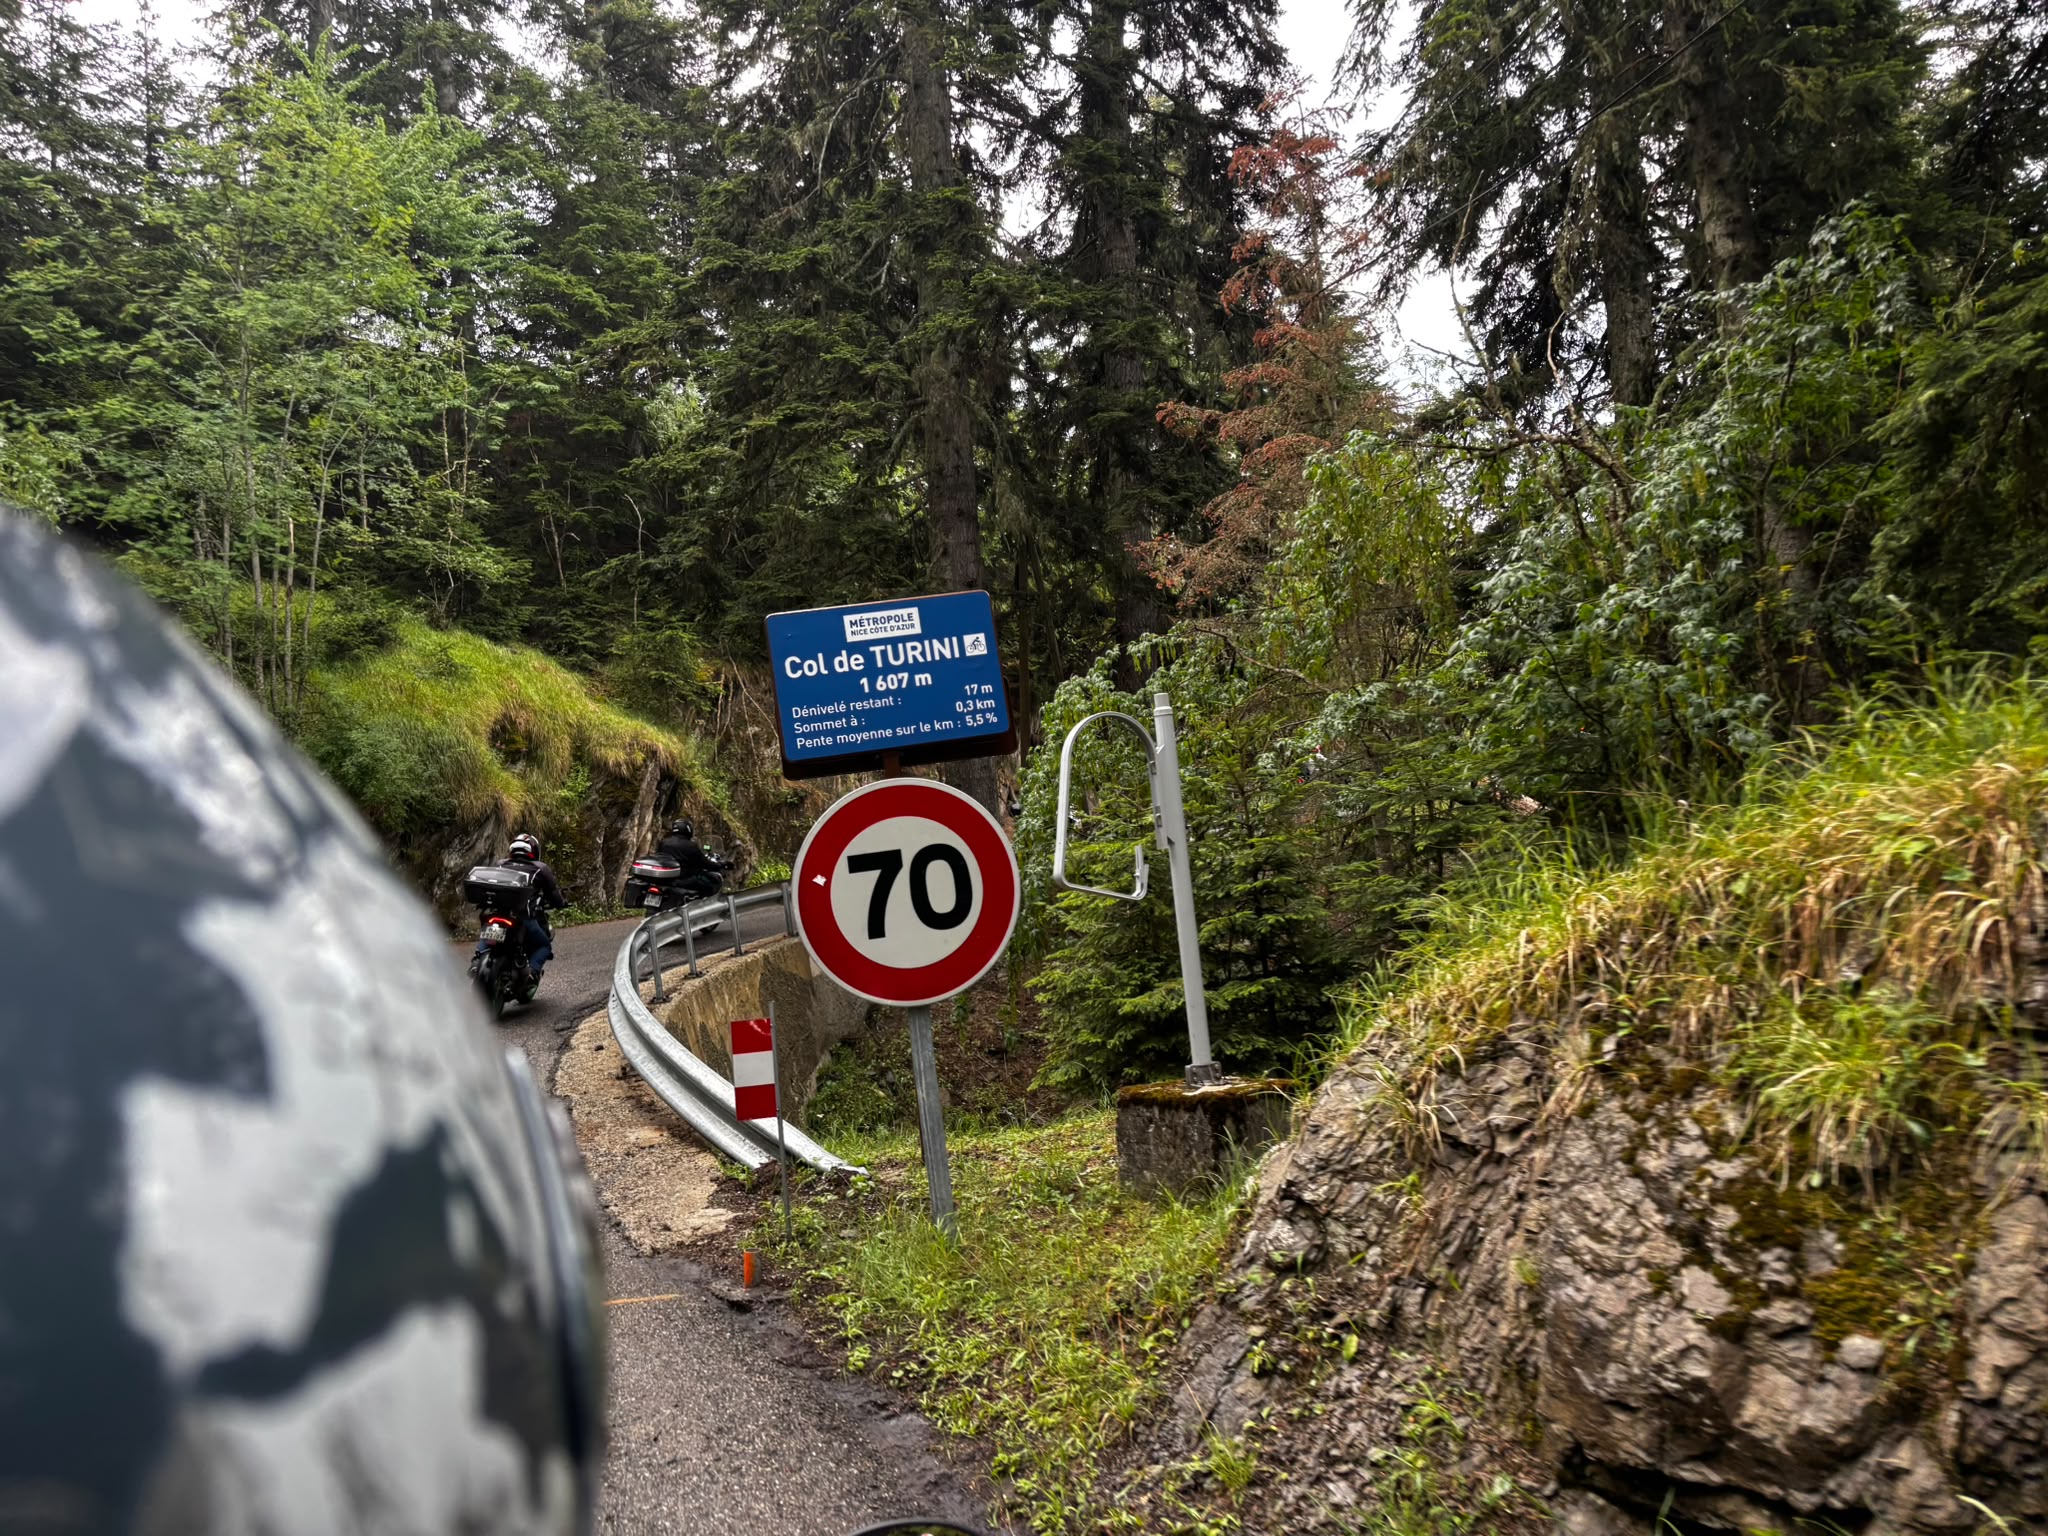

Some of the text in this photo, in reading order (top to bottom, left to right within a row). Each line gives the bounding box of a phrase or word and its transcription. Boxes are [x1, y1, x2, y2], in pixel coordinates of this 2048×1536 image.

[849, 612, 914, 629] MÉTROPOLE
[851, 623, 916, 636] NICE CÔTE D'AZUR
[785, 637, 960, 679] Col de TURINI
[860, 673, 932, 693] 1 607 m
[792, 701, 846, 718] Dénivelé
[850, 697, 894, 711] restant
[964, 685, 978, 695] 17
[981, 685, 993, 693] m
[794, 719, 847, 734] Sommet
[851, 715, 858, 727] à
[956, 701, 974, 713] 0,3
[976, 699, 995, 710] km
[797, 735, 833, 749] Pente
[837, 728, 893, 744] moyenne
[896, 726, 915, 737] sur
[920, 722, 931, 733] le
[935, 719, 953, 730] km
[966, 715, 984, 727] 5,5
[986, 712, 998, 723] %
[847, 843, 973, 940] 70
